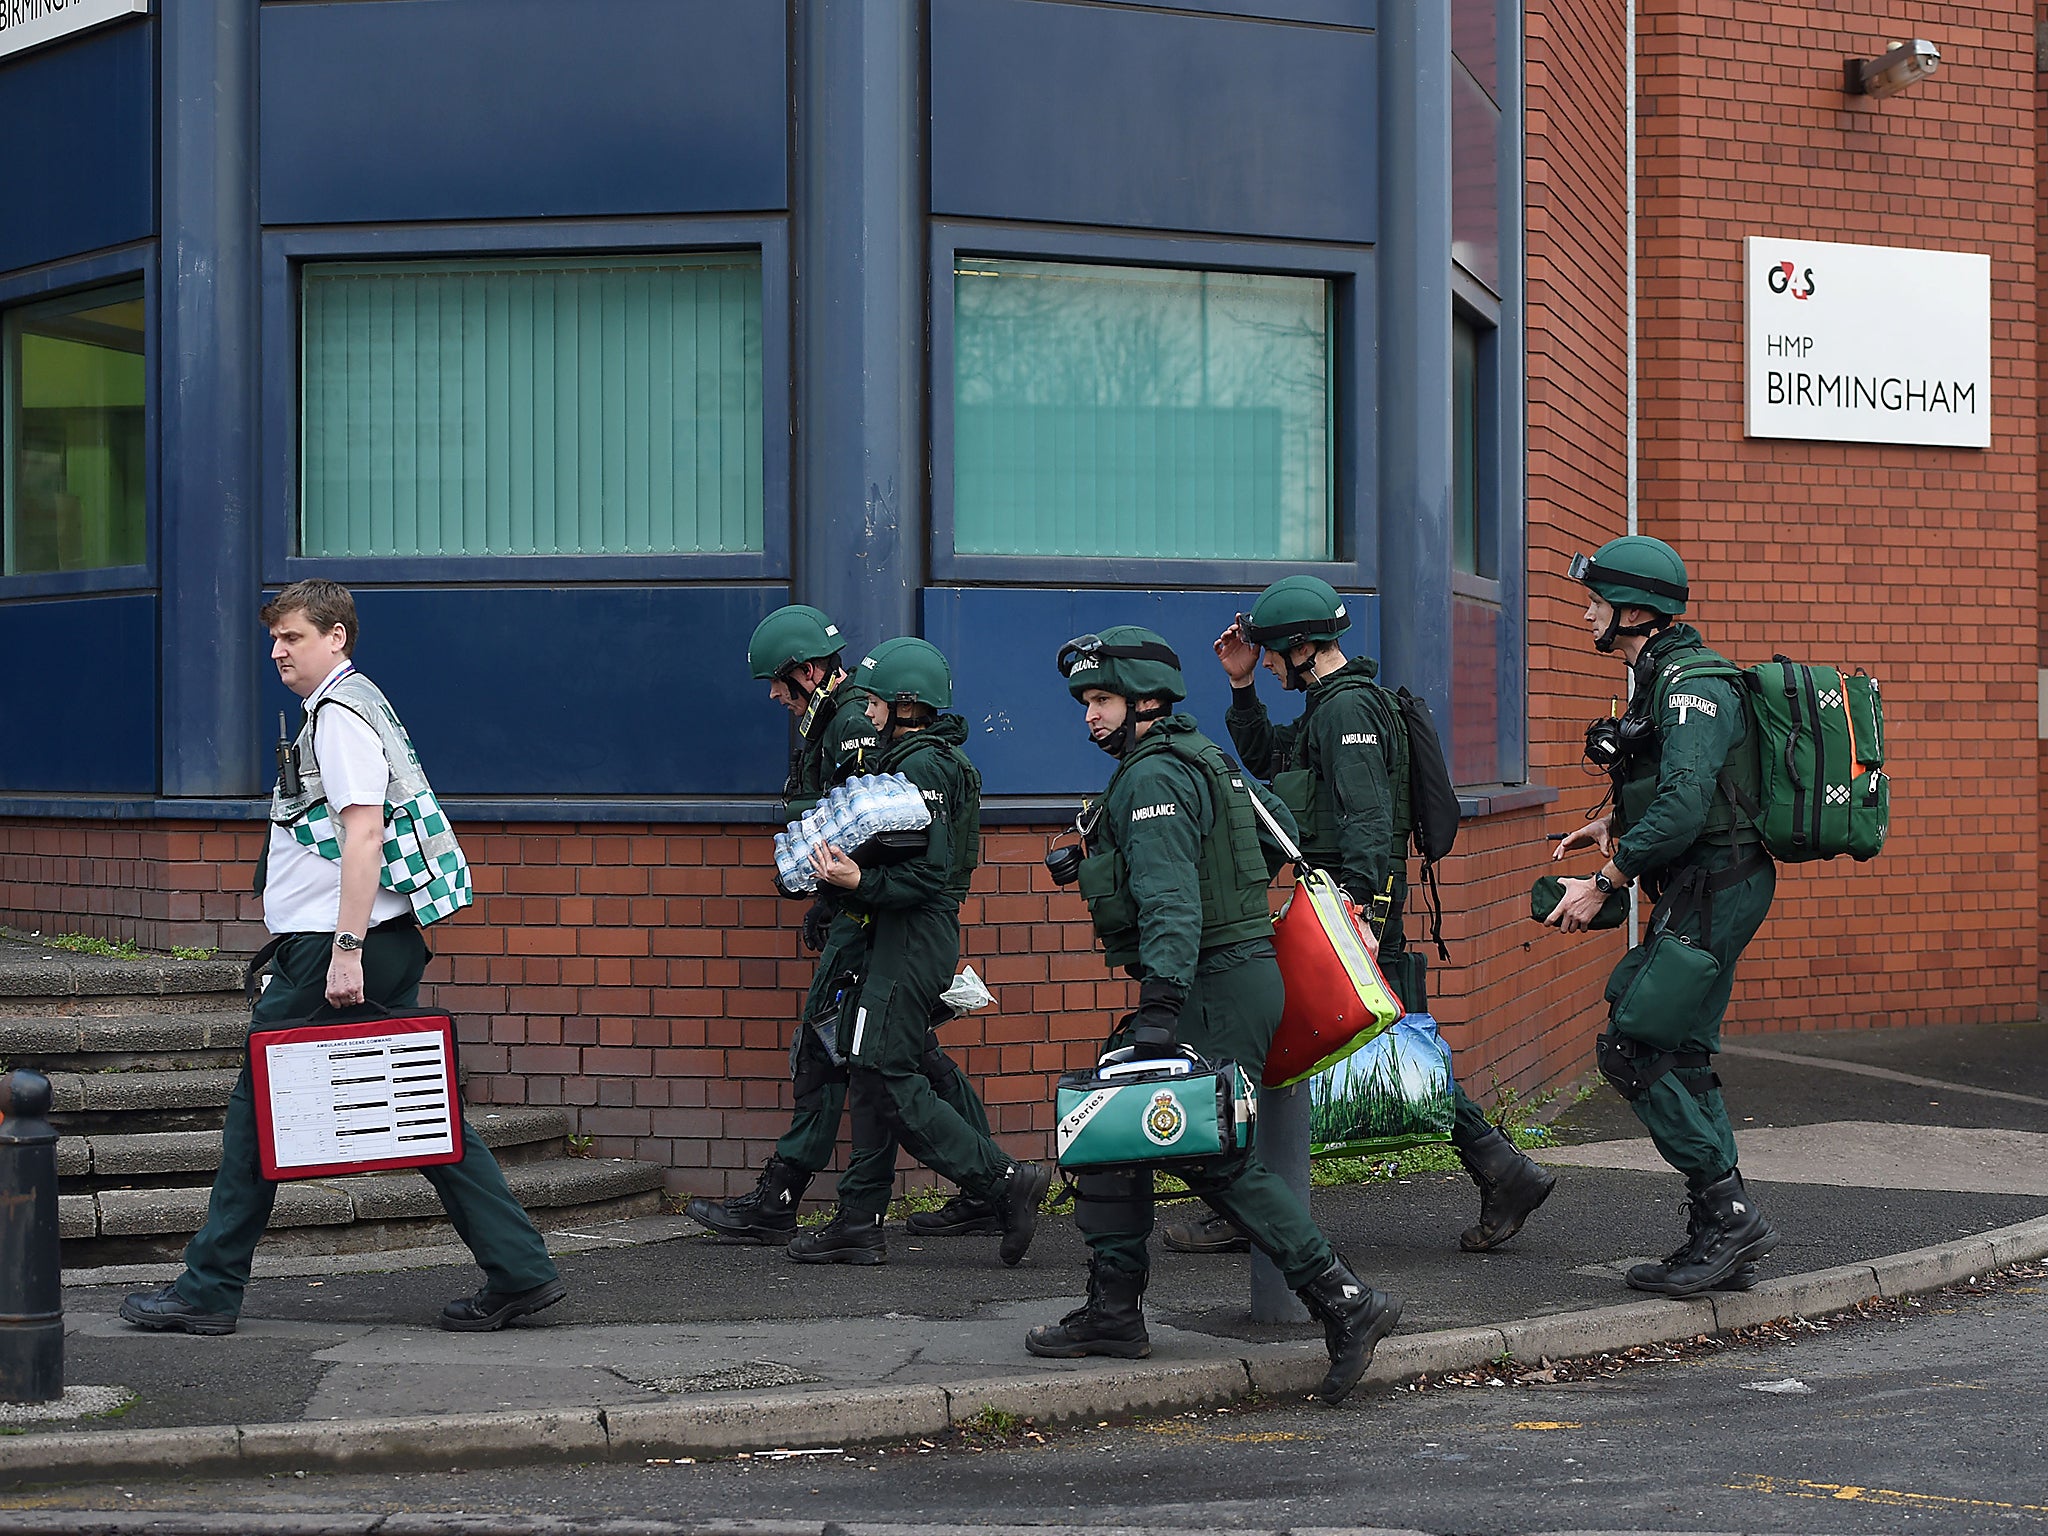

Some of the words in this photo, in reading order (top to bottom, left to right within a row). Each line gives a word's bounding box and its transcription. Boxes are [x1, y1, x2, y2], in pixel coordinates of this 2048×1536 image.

[1768, 261, 1815, 300] G4S
[1768, 334, 1814, 358] HMP
[1768, 371, 1975, 414] BIRMINGHAM
[1670, 694, 1717, 717] AMBULANCE
[1341, 733, 1378, 745] AMBULANCE
[1131, 803, 1176, 822] AMBULANCE
[1060, 1125, 1073, 1138] X
[1070, 1094, 1105, 1126] Series
